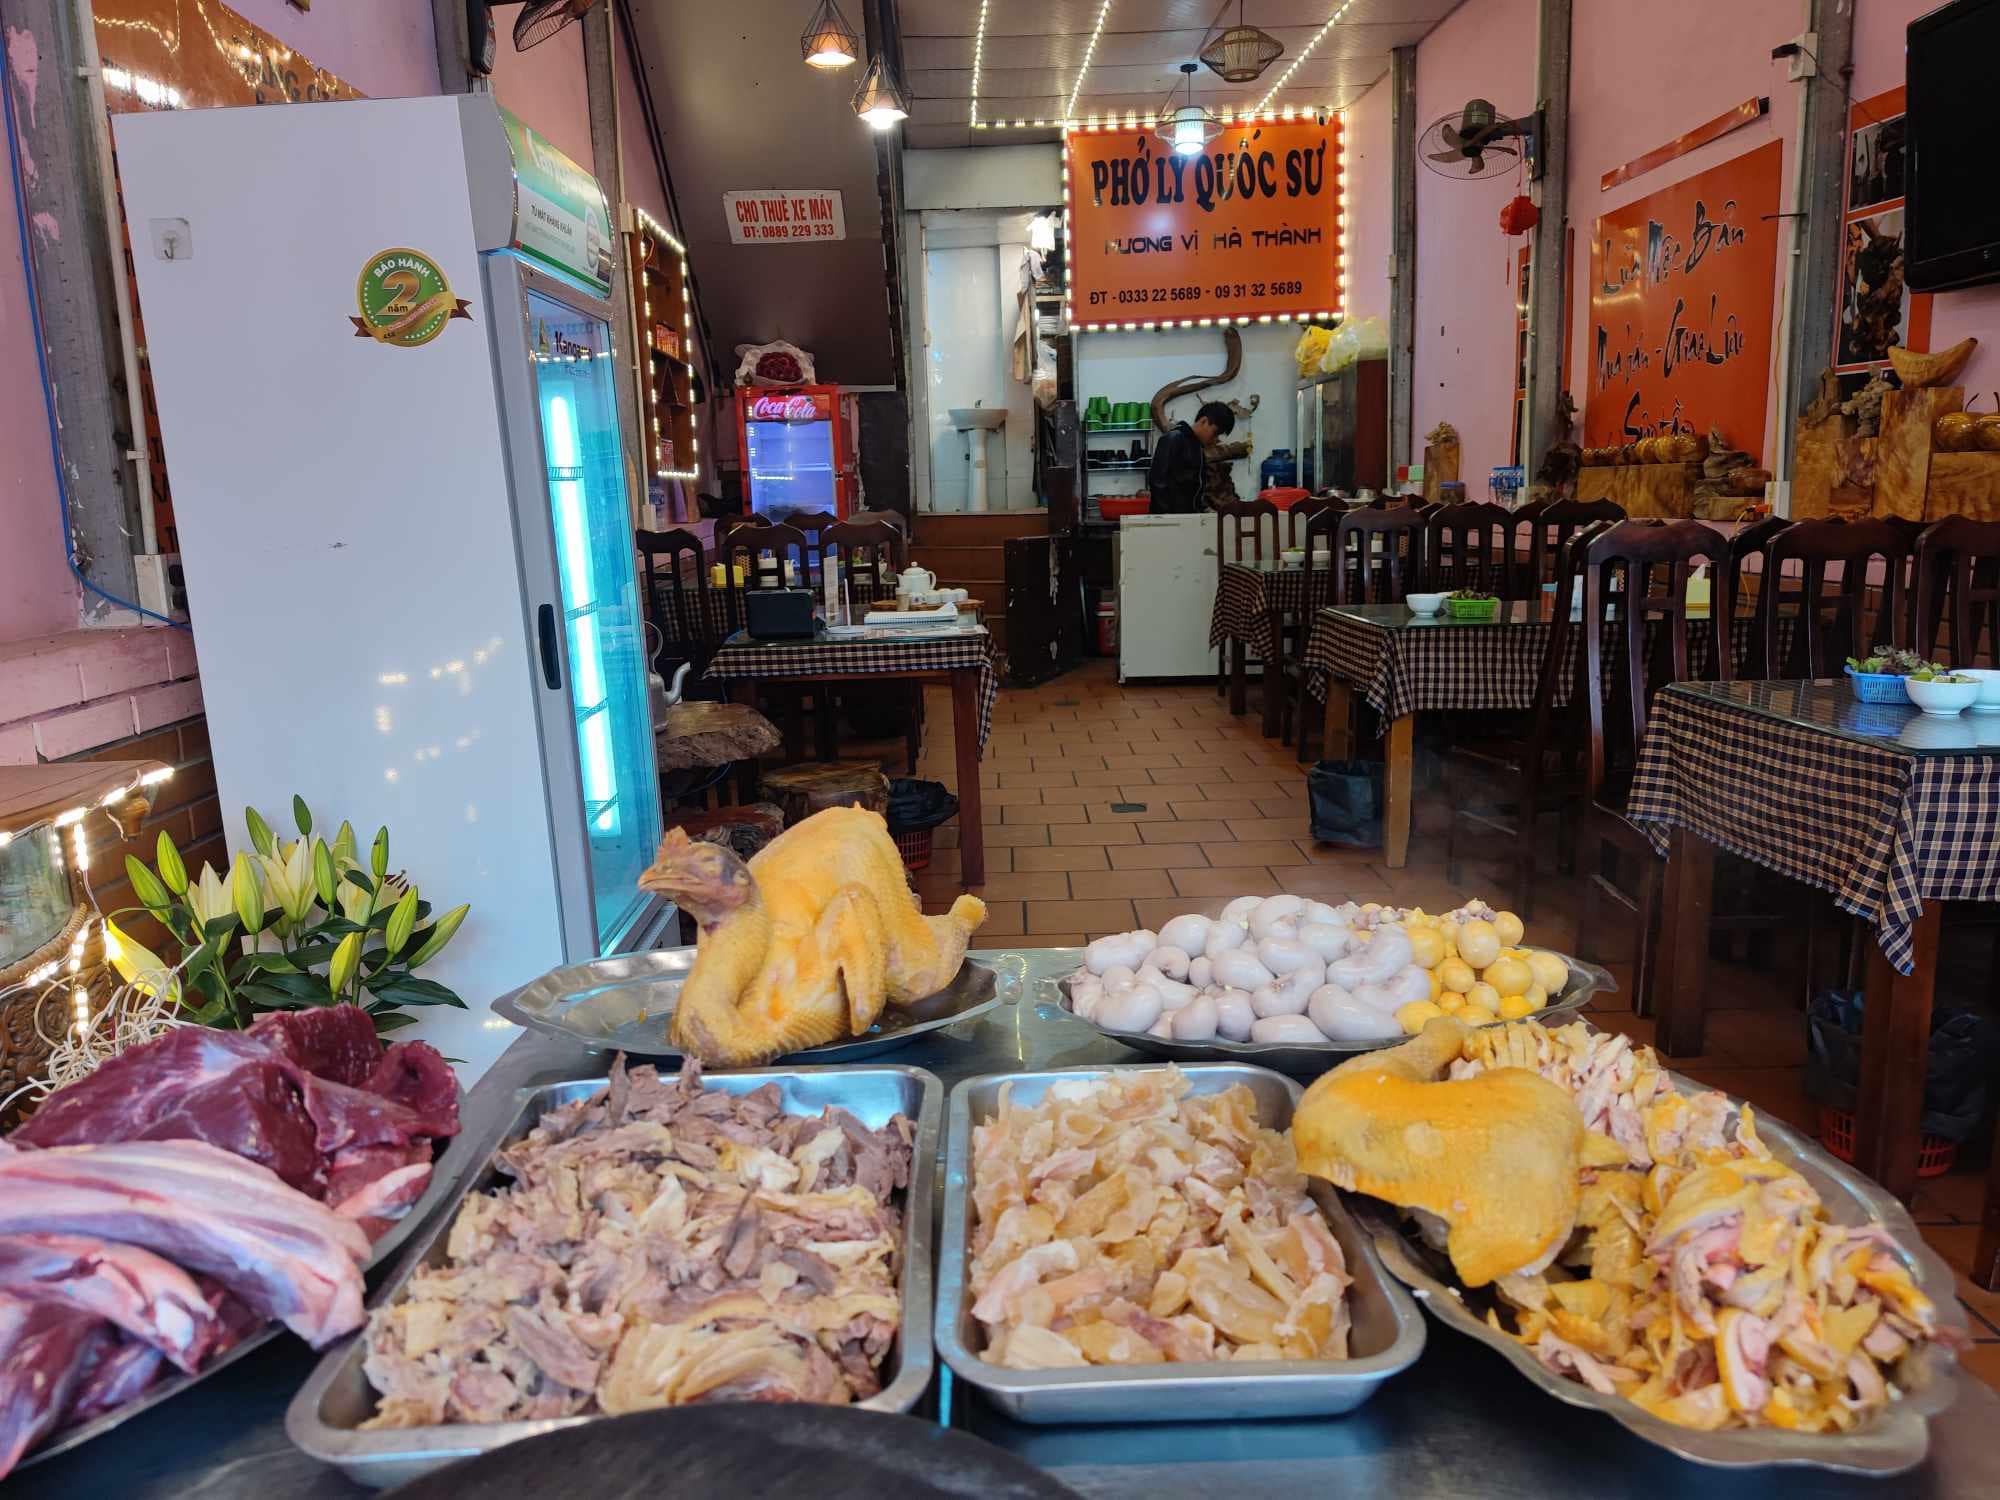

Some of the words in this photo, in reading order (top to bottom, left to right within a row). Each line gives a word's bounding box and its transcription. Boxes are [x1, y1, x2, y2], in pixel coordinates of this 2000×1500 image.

[736, 200, 759, 223] CHO
[791, 199, 807, 221] XE
[762, 225, 788, 238] 0889
[792, 224, 811, 237] 229
[814, 223, 834, 236] 333
[1213, 226, 1242, 249] HÀ
[1251, 222, 1322, 248] THÀNH
[380, 270, 420, 315] 2
[1089, 290, 1107, 305] ĐT
[1118, 288, 1149, 304] 0333
[1151, 287, 1168, 302] 22
[1170, 286, 1201, 301] 5689
[1215, 285, 1231, 299] 09
[1233, 283, 1247, 298] 31
[1250, 282, 1266, 297] 32
[1270, 280, 1303, 296] 5689
[387, 304, 409, 313] năm
